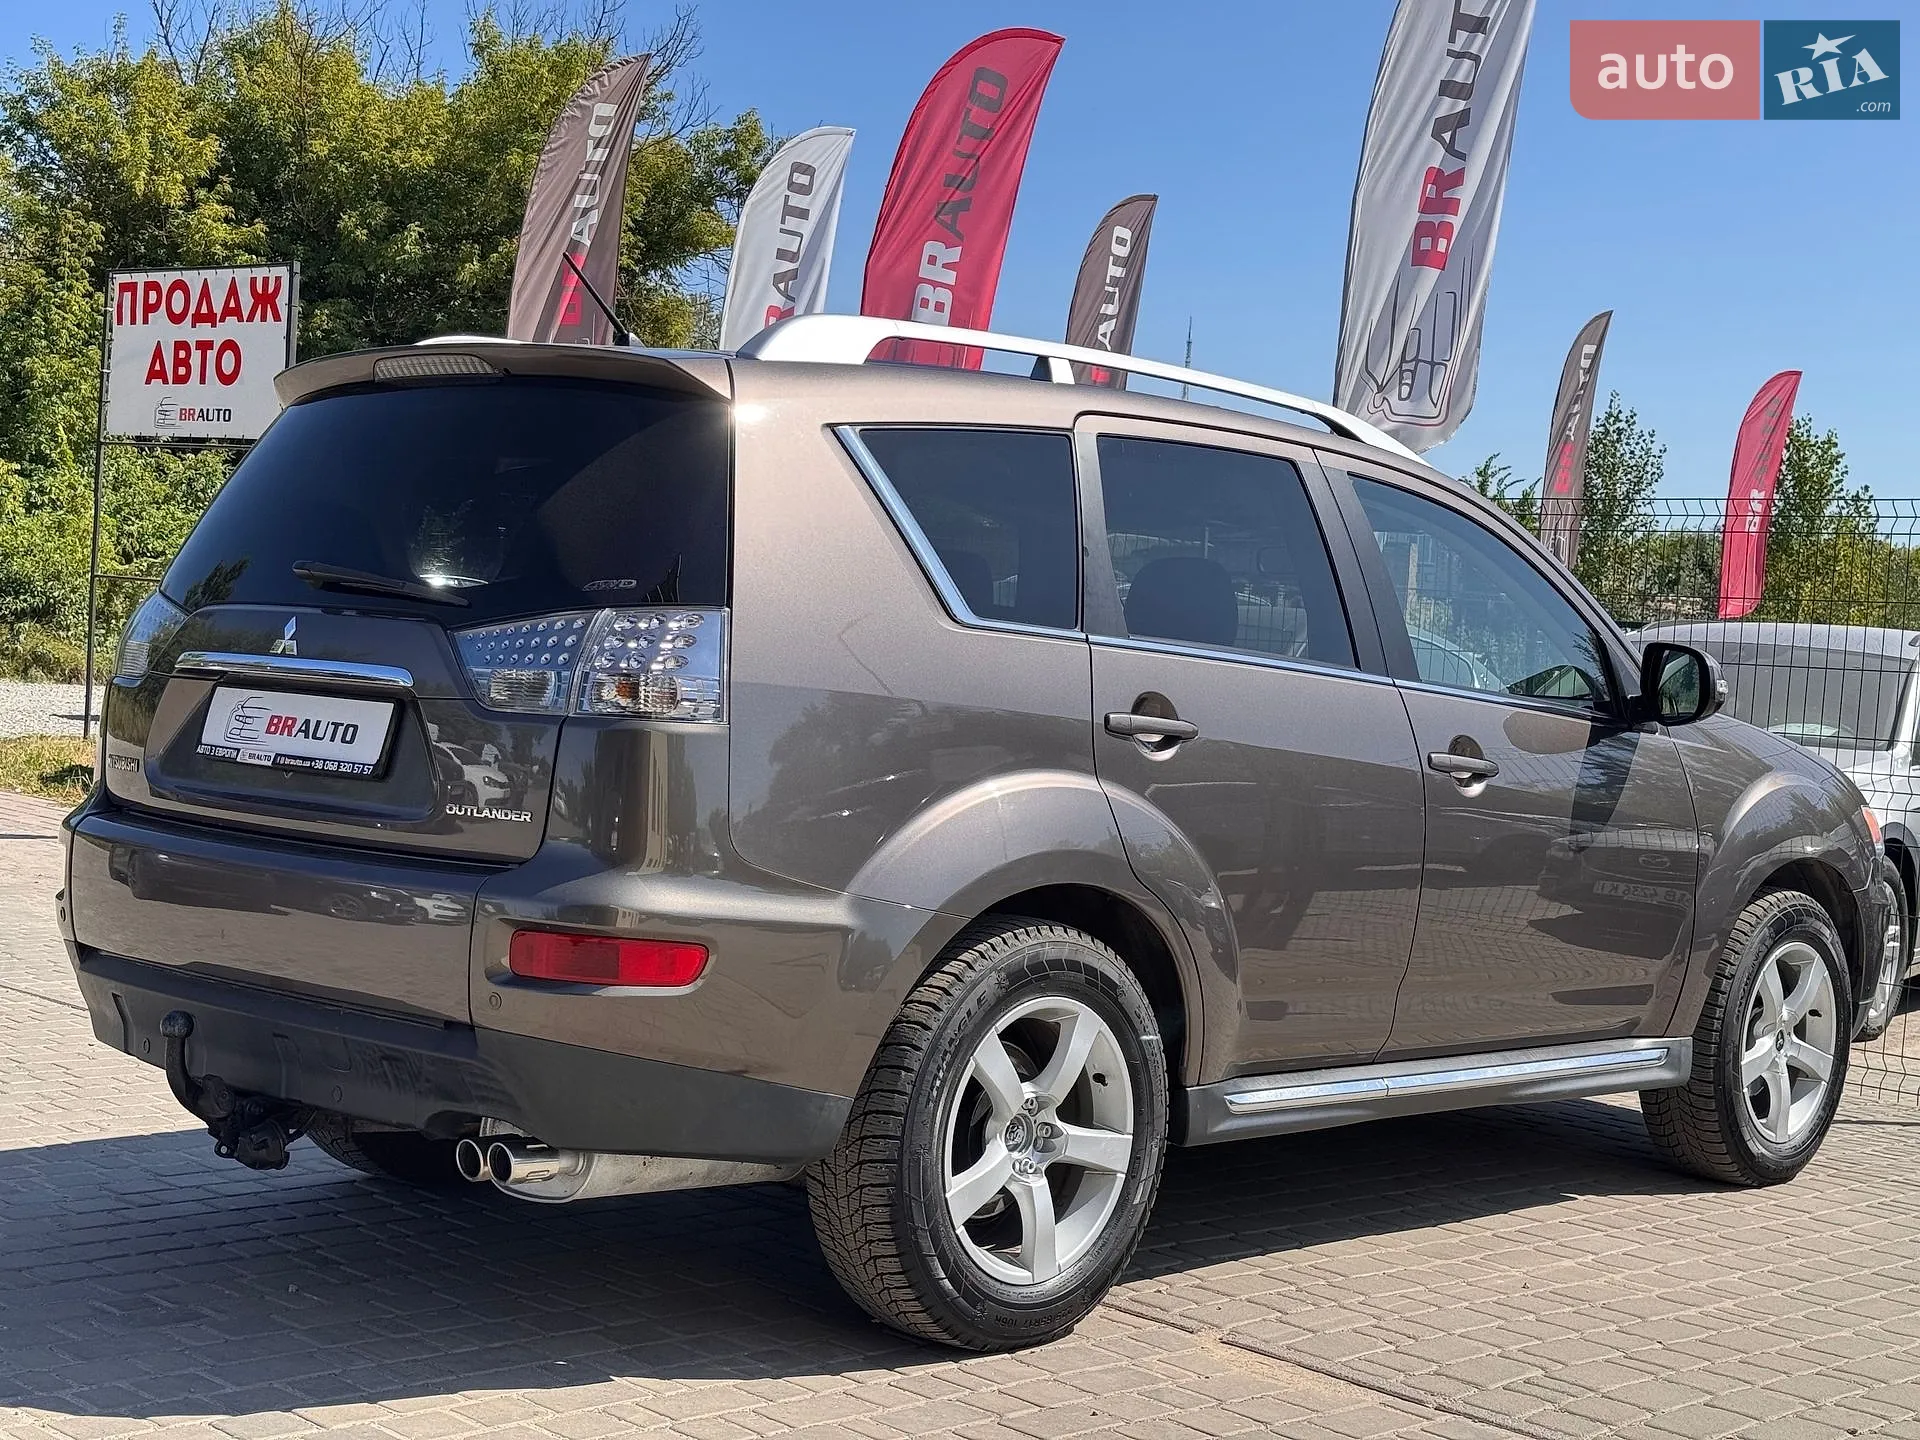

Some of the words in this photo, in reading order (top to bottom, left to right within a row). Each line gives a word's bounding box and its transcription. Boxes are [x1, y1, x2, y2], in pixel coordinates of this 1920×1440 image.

[1411, 0, 1490, 271] BRAUT
[911, 66, 1008, 326] BRAUTO
[765, 161, 816, 328] RAUTO
[116, 275, 282, 329] ПРОДАЖ
[144, 338, 242, 386] АВТО
[178, 408, 232, 422] BRAUTO
[265, 714, 359, 745] BRAUTO
[196, 744, 211, 755] АВТО
[247, 752, 272, 762] BRAUTO
[311, 760, 324, 770] +38
[324, 761, 338, 771] 068
[338, 763, 353, 773] 320
[353, 764, 363, 774] 57
[363, 765, 374, 775] 57
[445, 803, 533, 823] OUTLANDER
